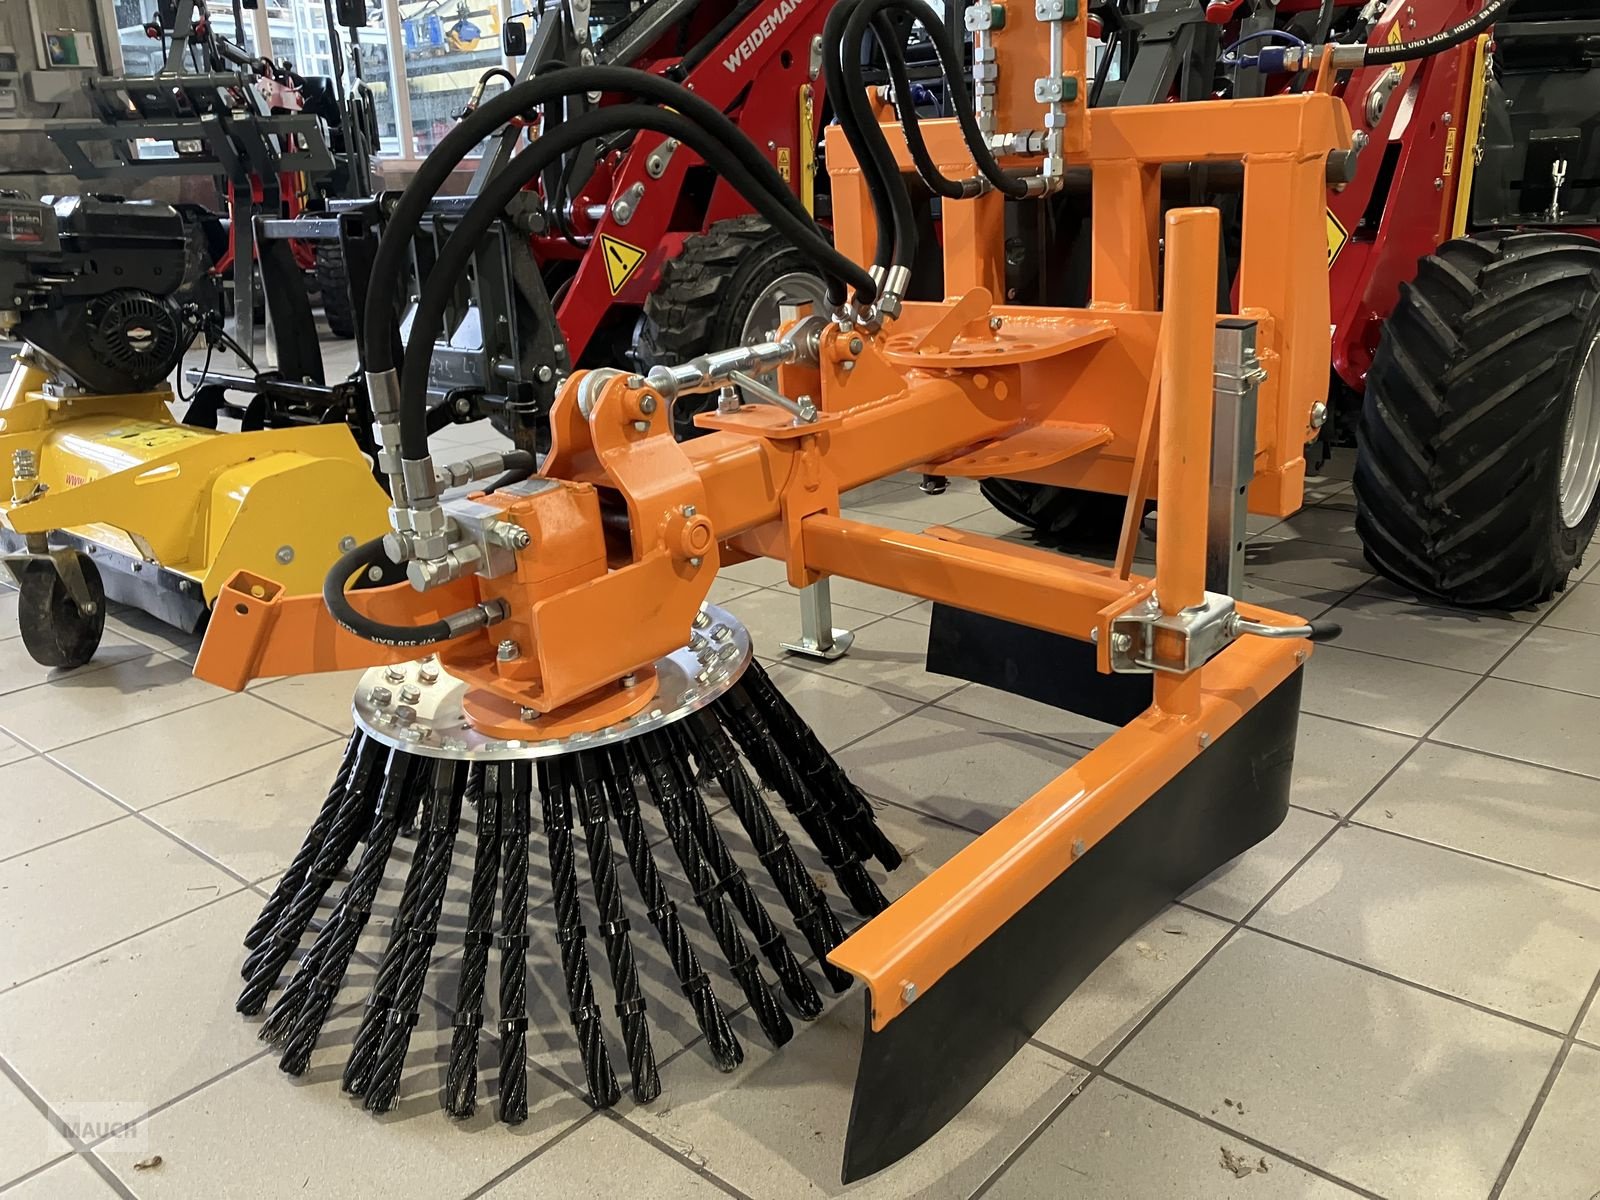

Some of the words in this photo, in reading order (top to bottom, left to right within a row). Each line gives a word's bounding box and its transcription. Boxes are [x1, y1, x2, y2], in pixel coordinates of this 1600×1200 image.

[1368, 44, 1406, 54] BRESSEL
[1408, 40, 1426, 49] UND
[1427, 31, 1449, 44] LADE
[1453, 19, 1476, 35] HD213
